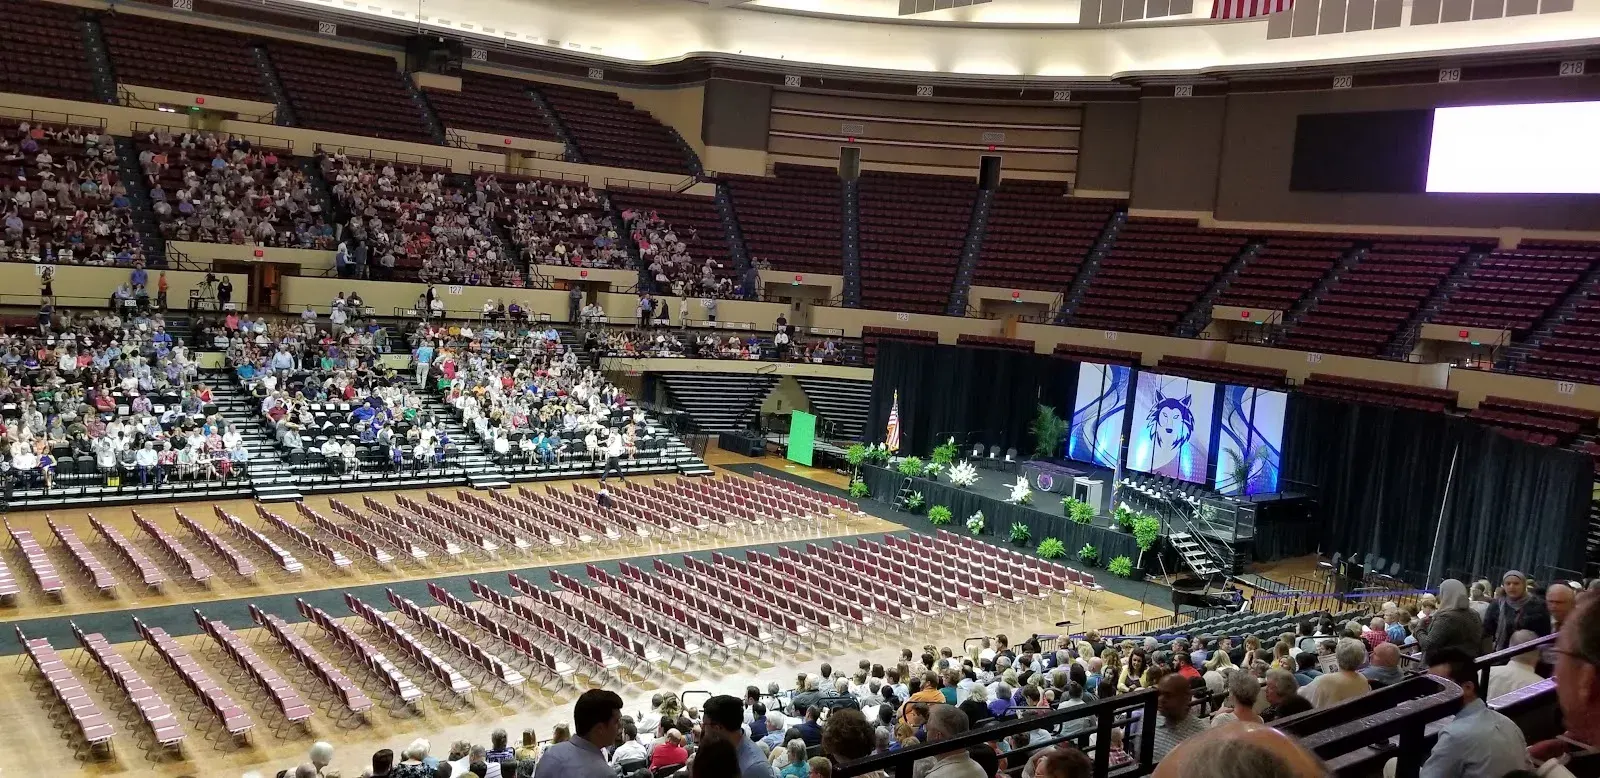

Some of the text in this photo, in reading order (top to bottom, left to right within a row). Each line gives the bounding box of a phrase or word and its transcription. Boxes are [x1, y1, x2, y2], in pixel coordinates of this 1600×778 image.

[173, 0, 192, 10] 228
[319, 22, 336, 34] 227
[472, 48, 487, 60] 226
[1561, 61, 1583, 75] 218
[589, 68, 603, 79] 225
[1440, 69, 1459, 82] 219
[785, 75, 801, 87] 224
[1334, 76, 1352, 88] 220
[917, 86, 933, 96] 223
[1054, 91, 1070, 101] 222
[1176, 86, 1192, 96] 221
[449, 286, 462, 294] 127
[1105, 331, 1117, 339] 121
[1308, 353, 1322, 363] 119
[1559, 382, 1574, 392] 117
